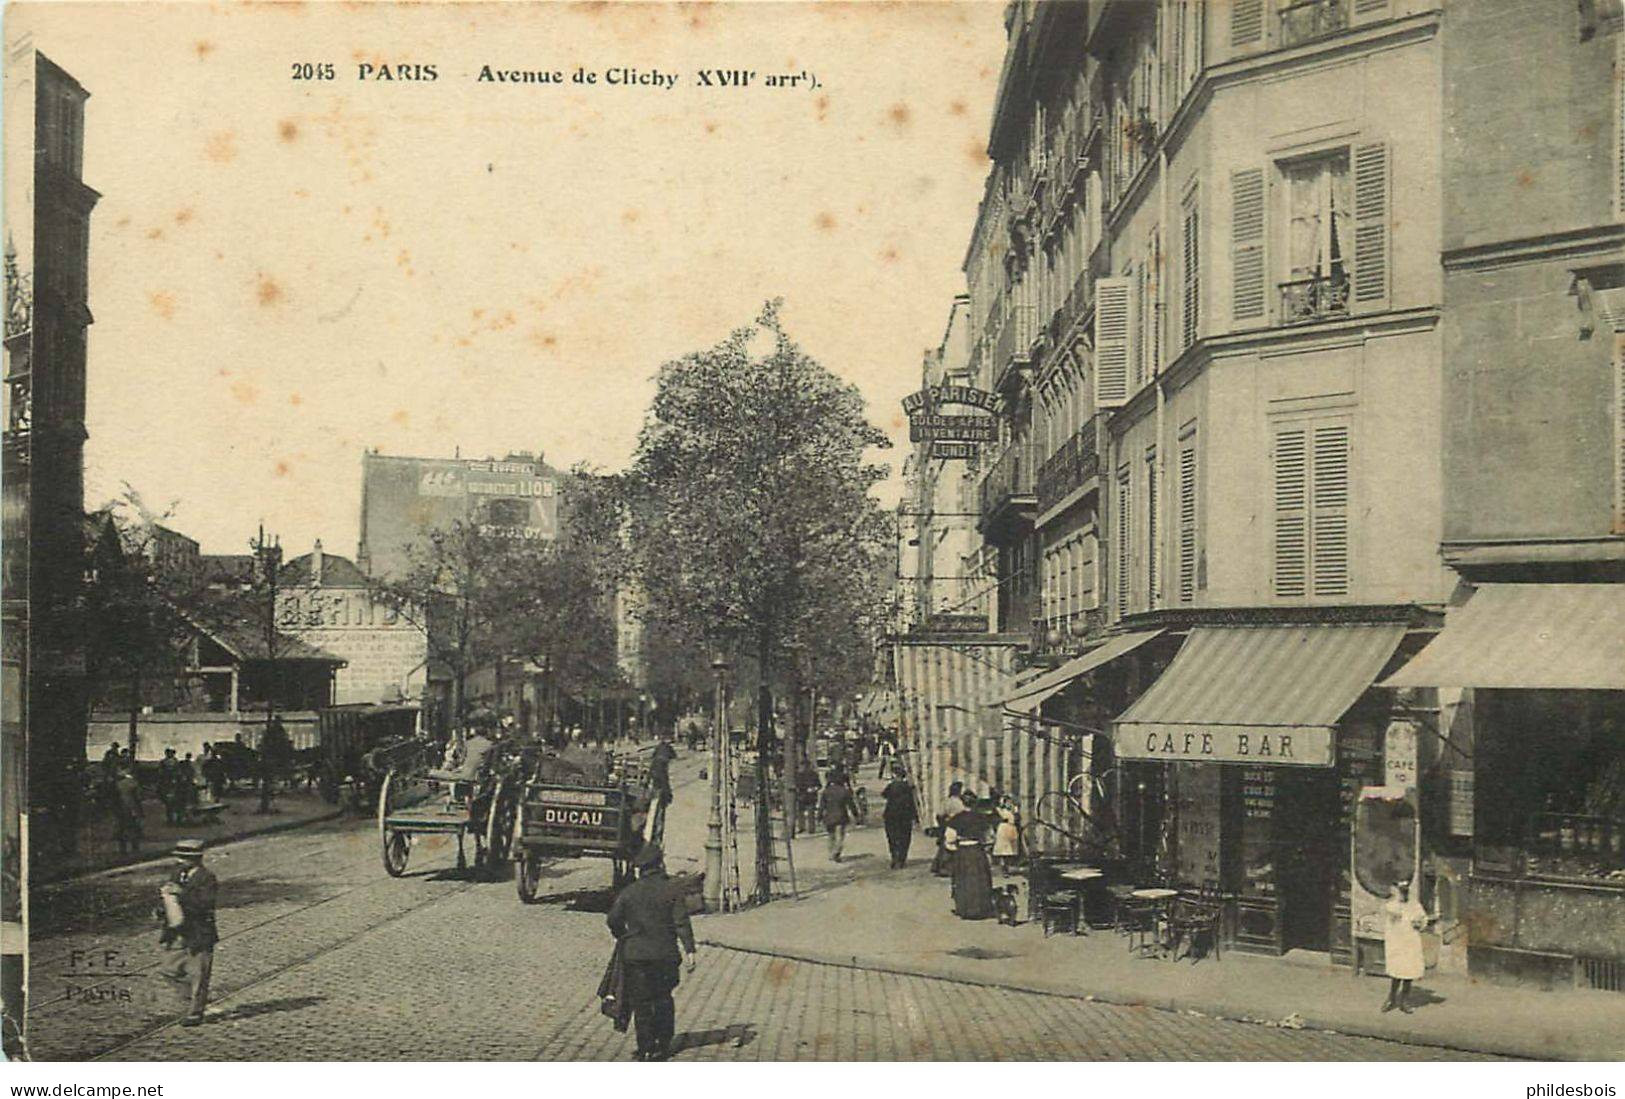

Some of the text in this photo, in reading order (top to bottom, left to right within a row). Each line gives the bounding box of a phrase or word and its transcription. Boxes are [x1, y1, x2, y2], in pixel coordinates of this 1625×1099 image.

[903, 387, 1007, 413] AU PARISIEN
[919, 427, 991, 440] INVENTAIRE
[933, 444, 974, 457] LUNDI
[1146, 732, 1294, 757] CAFE BAR
[545, 809, 603, 826] DUCAU
